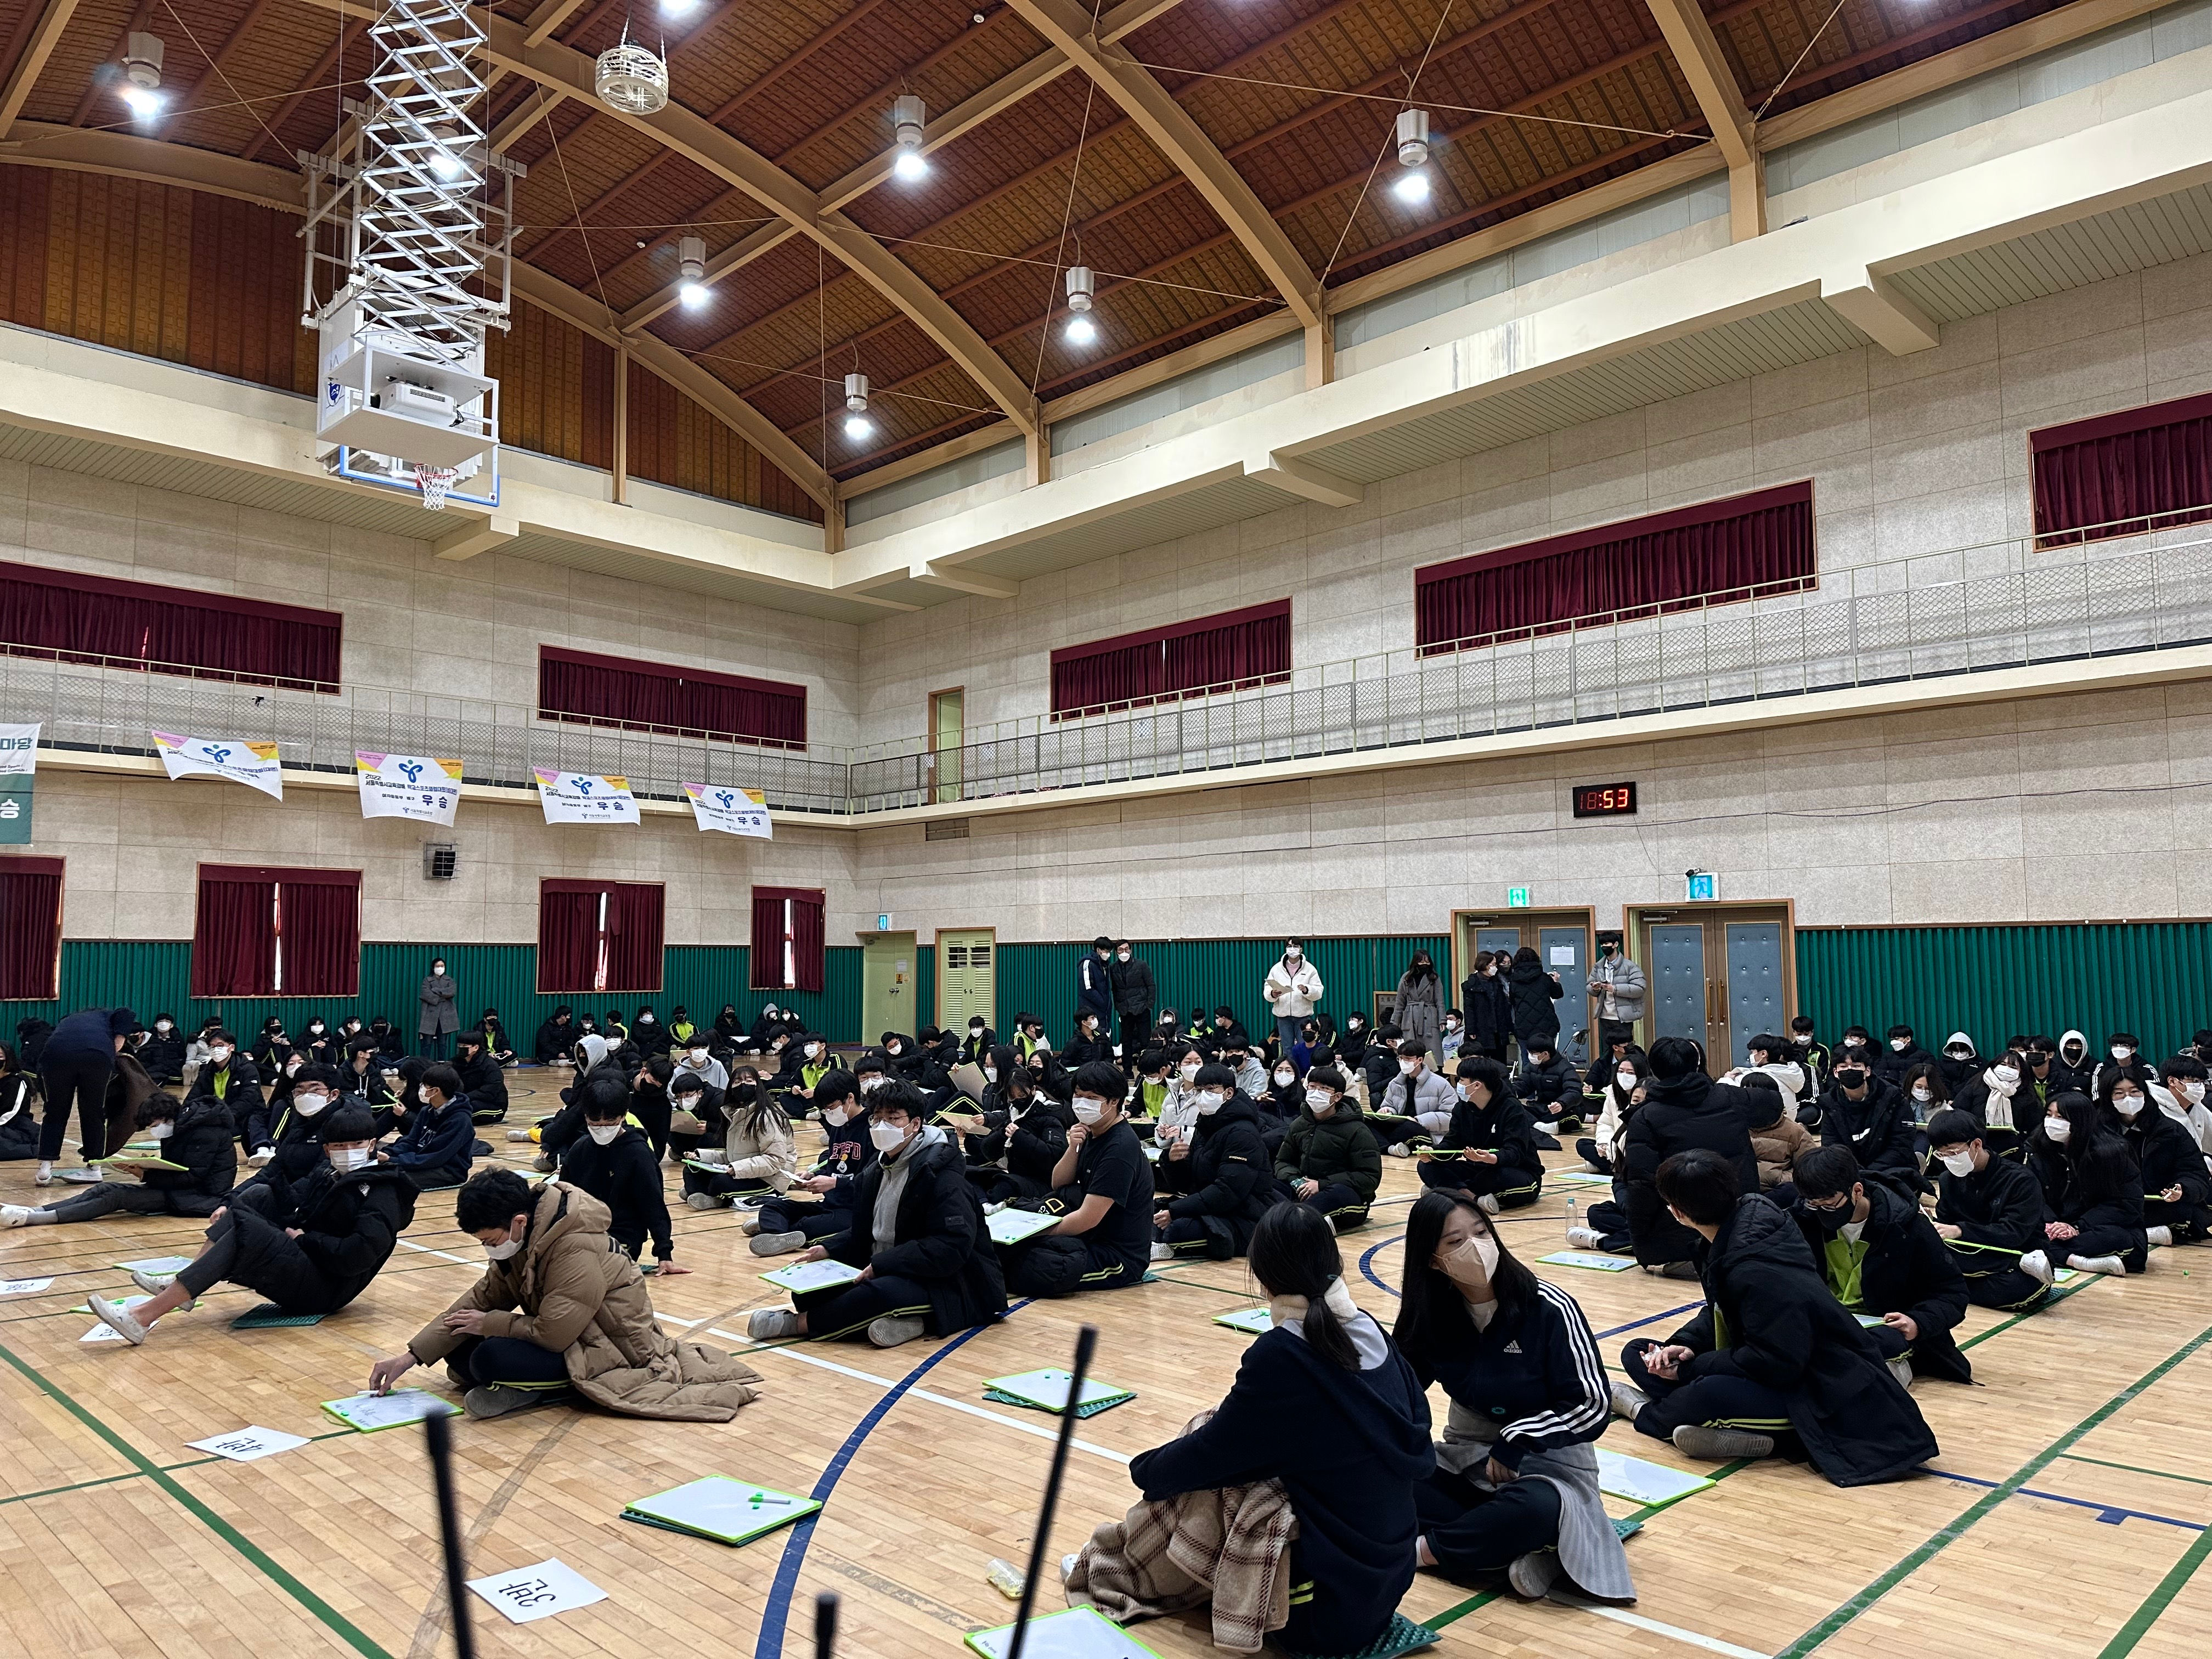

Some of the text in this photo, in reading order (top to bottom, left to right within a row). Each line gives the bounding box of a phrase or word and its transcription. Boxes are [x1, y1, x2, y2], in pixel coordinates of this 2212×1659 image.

[0, 799, 20, 819] 승
[1580, 789, 1628, 809] 18:53
[216, 1438, 264, 1453] 4반
[499, 1578, 556, 1607] 3반
